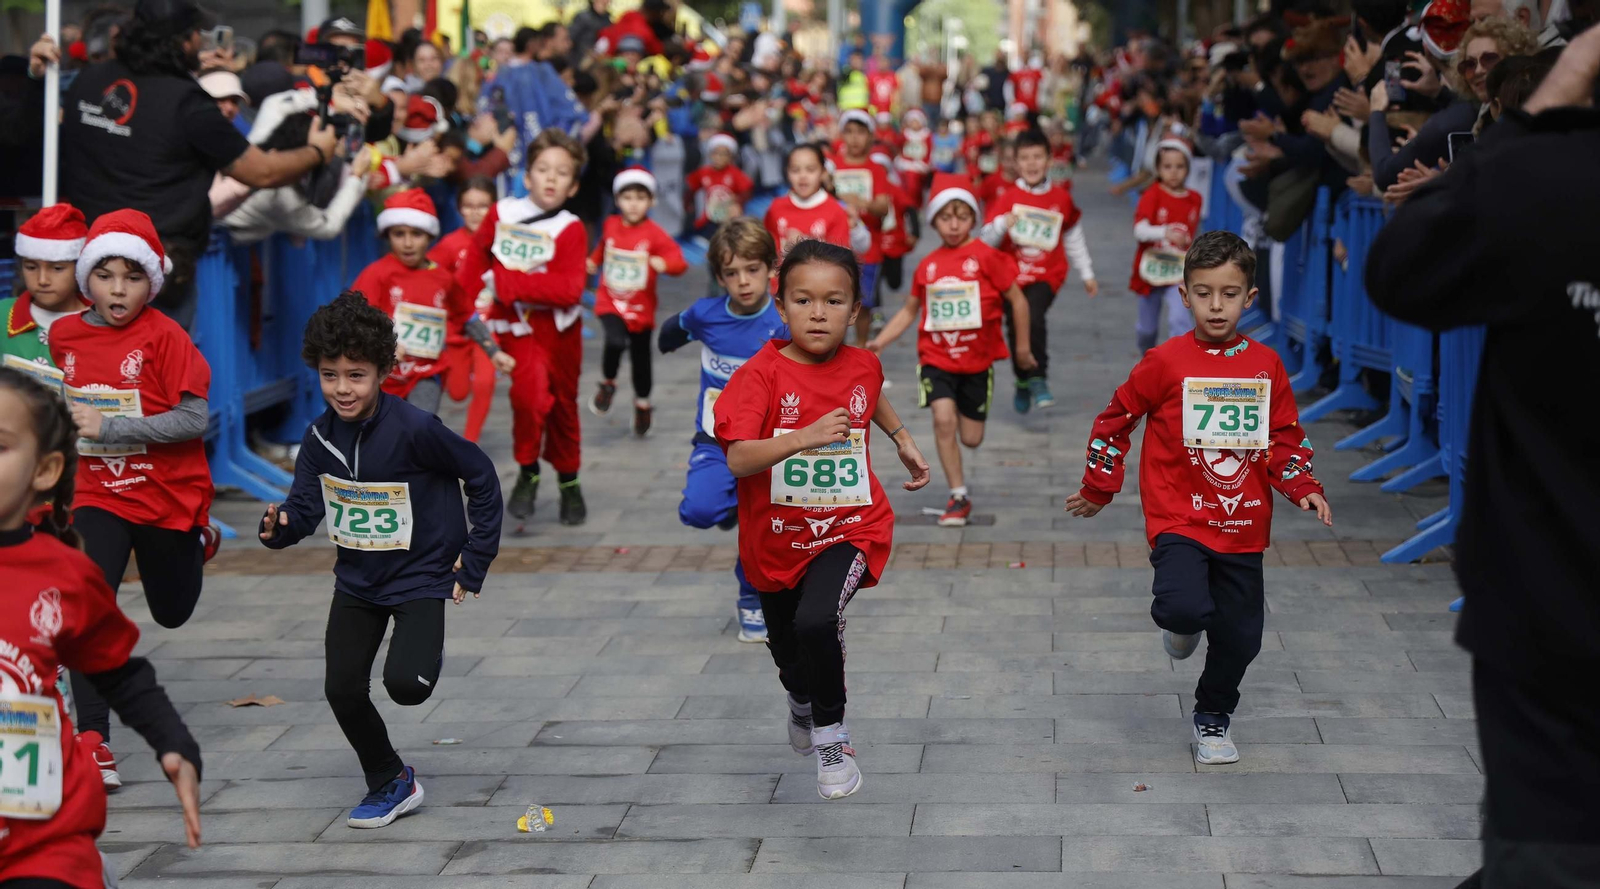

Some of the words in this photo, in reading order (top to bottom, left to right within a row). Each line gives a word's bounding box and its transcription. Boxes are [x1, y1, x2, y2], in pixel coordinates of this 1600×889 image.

[931, 301, 970, 318] 698
[401, 322, 443, 345] 741
[1193, 404, 1259, 431] 735
[784, 458, 858, 487] 683
[1202, 471, 1222, 489] CIUDAD
[329, 500, 399, 534] 723
[1208, 520, 1252, 528] CUPRA
[792, 534, 845, 548] CUPRA
